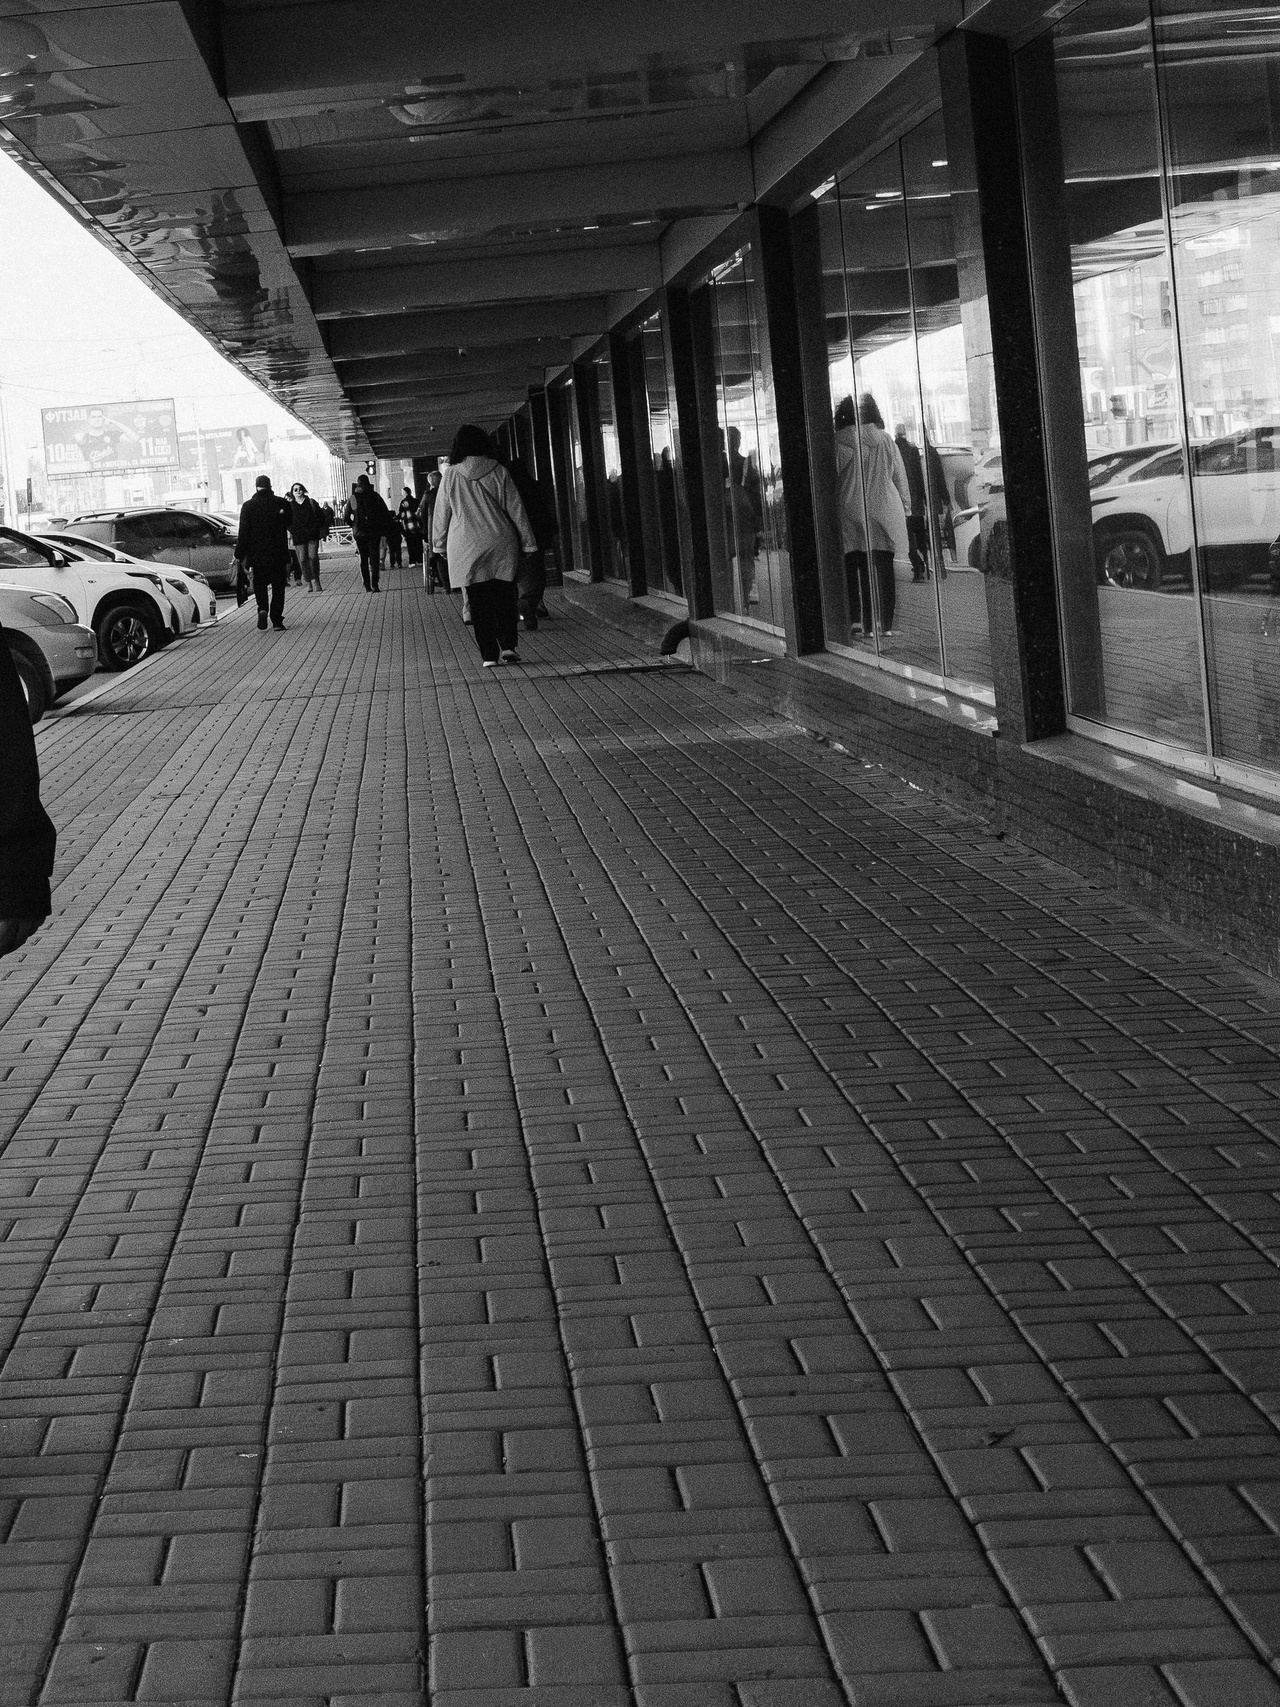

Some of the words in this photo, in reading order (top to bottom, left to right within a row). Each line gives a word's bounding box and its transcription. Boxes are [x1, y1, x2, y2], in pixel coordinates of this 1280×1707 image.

[45, 409, 87, 423] ФУТЗАЛ
[47, 443, 65, 463] 10
[139, 437, 154, 456] 11
